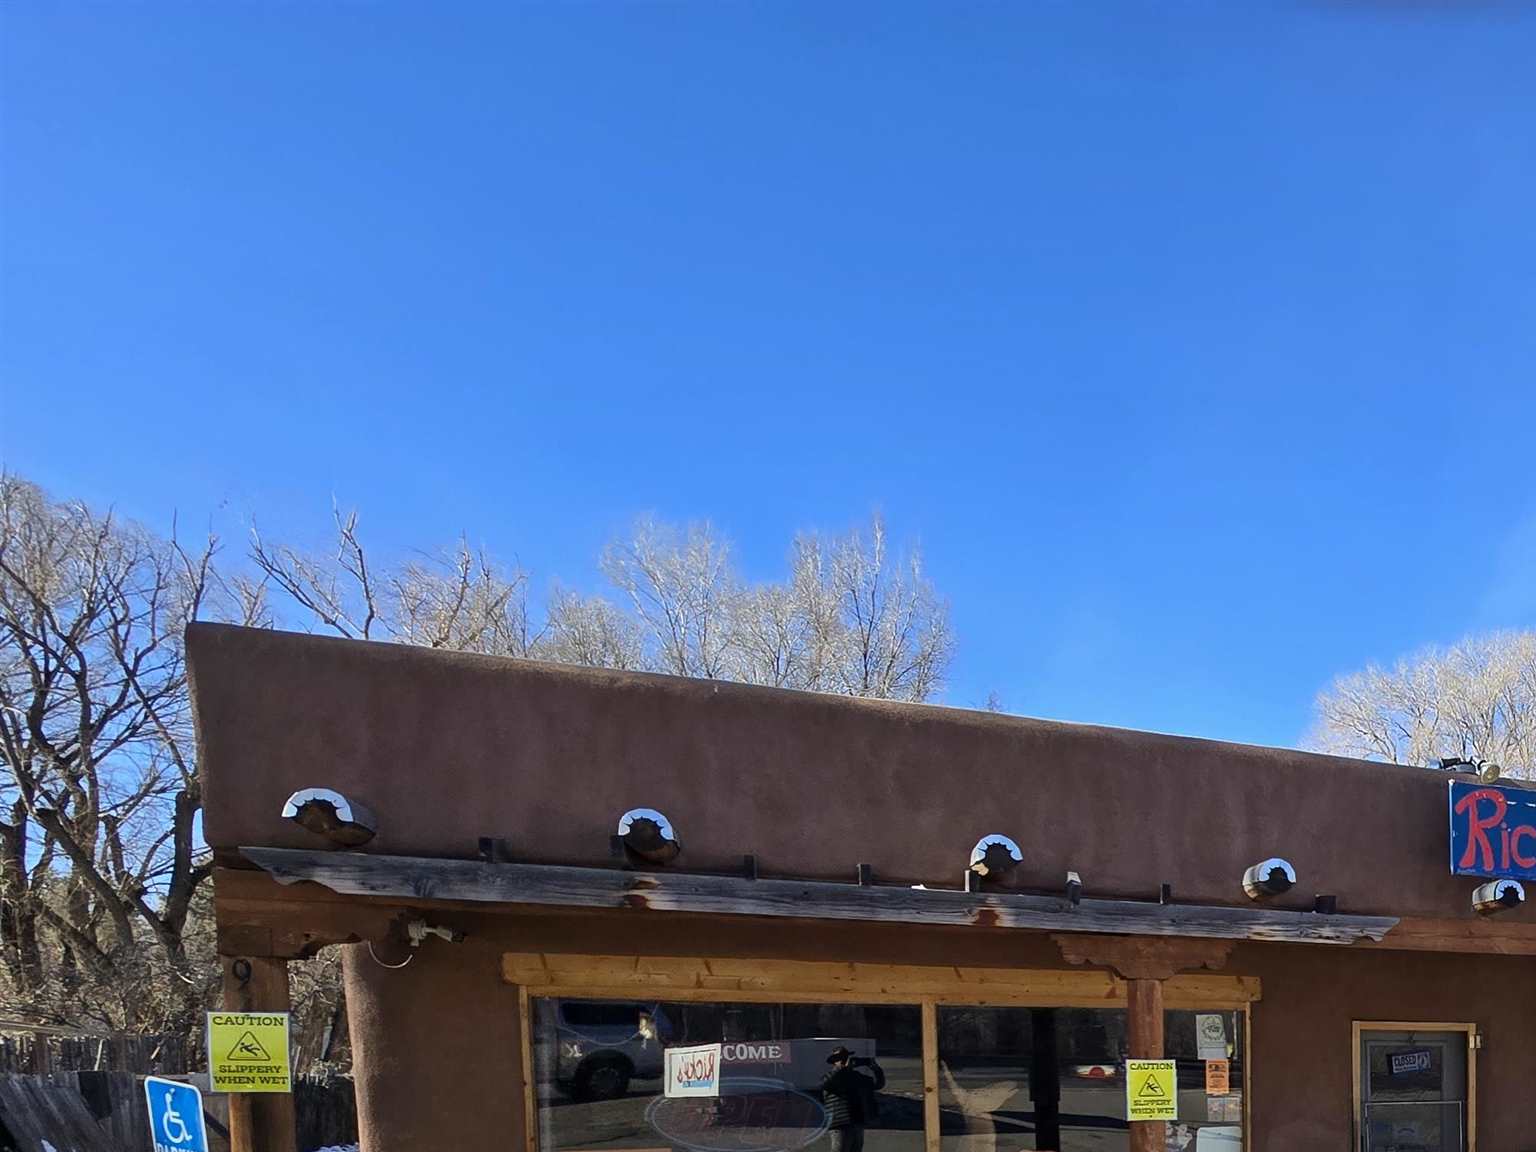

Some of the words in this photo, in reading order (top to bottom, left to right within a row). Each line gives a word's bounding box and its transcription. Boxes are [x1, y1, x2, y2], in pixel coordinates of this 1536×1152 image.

[212, 1015, 284, 1026] CAUTION
[720, 1043, 782, 1061] COME
[218, 1065, 281, 1074] SLIPPERY
[214, 1076, 256, 1085] WHEN
[258, 1076, 289, 1085] WET
